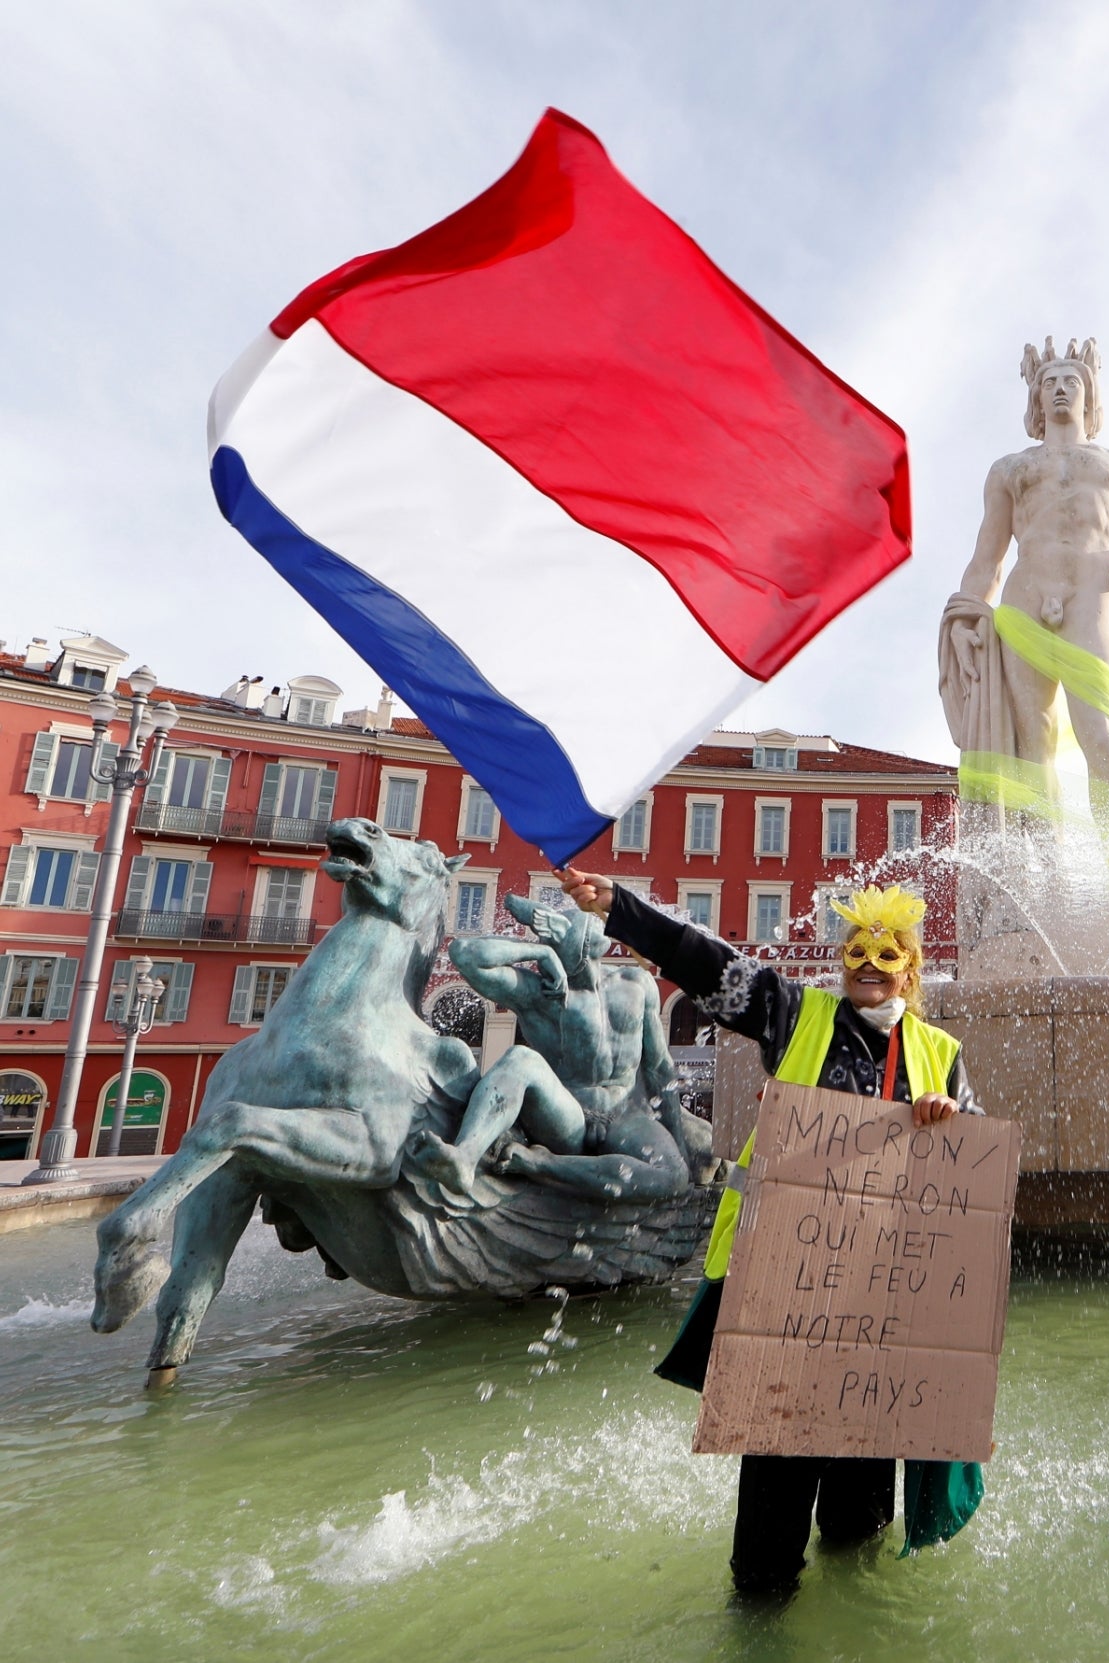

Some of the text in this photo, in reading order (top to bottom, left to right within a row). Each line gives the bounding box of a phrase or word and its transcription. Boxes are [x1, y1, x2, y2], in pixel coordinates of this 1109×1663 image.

[823, 1161, 969, 1216] NÉRON
[875, 1227, 952, 1259] MET
[795, 1260, 966, 1300] LE FEU À
[782, 1314, 901, 1352] NOTRE
[839, 1371, 928, 1414] PAYS
